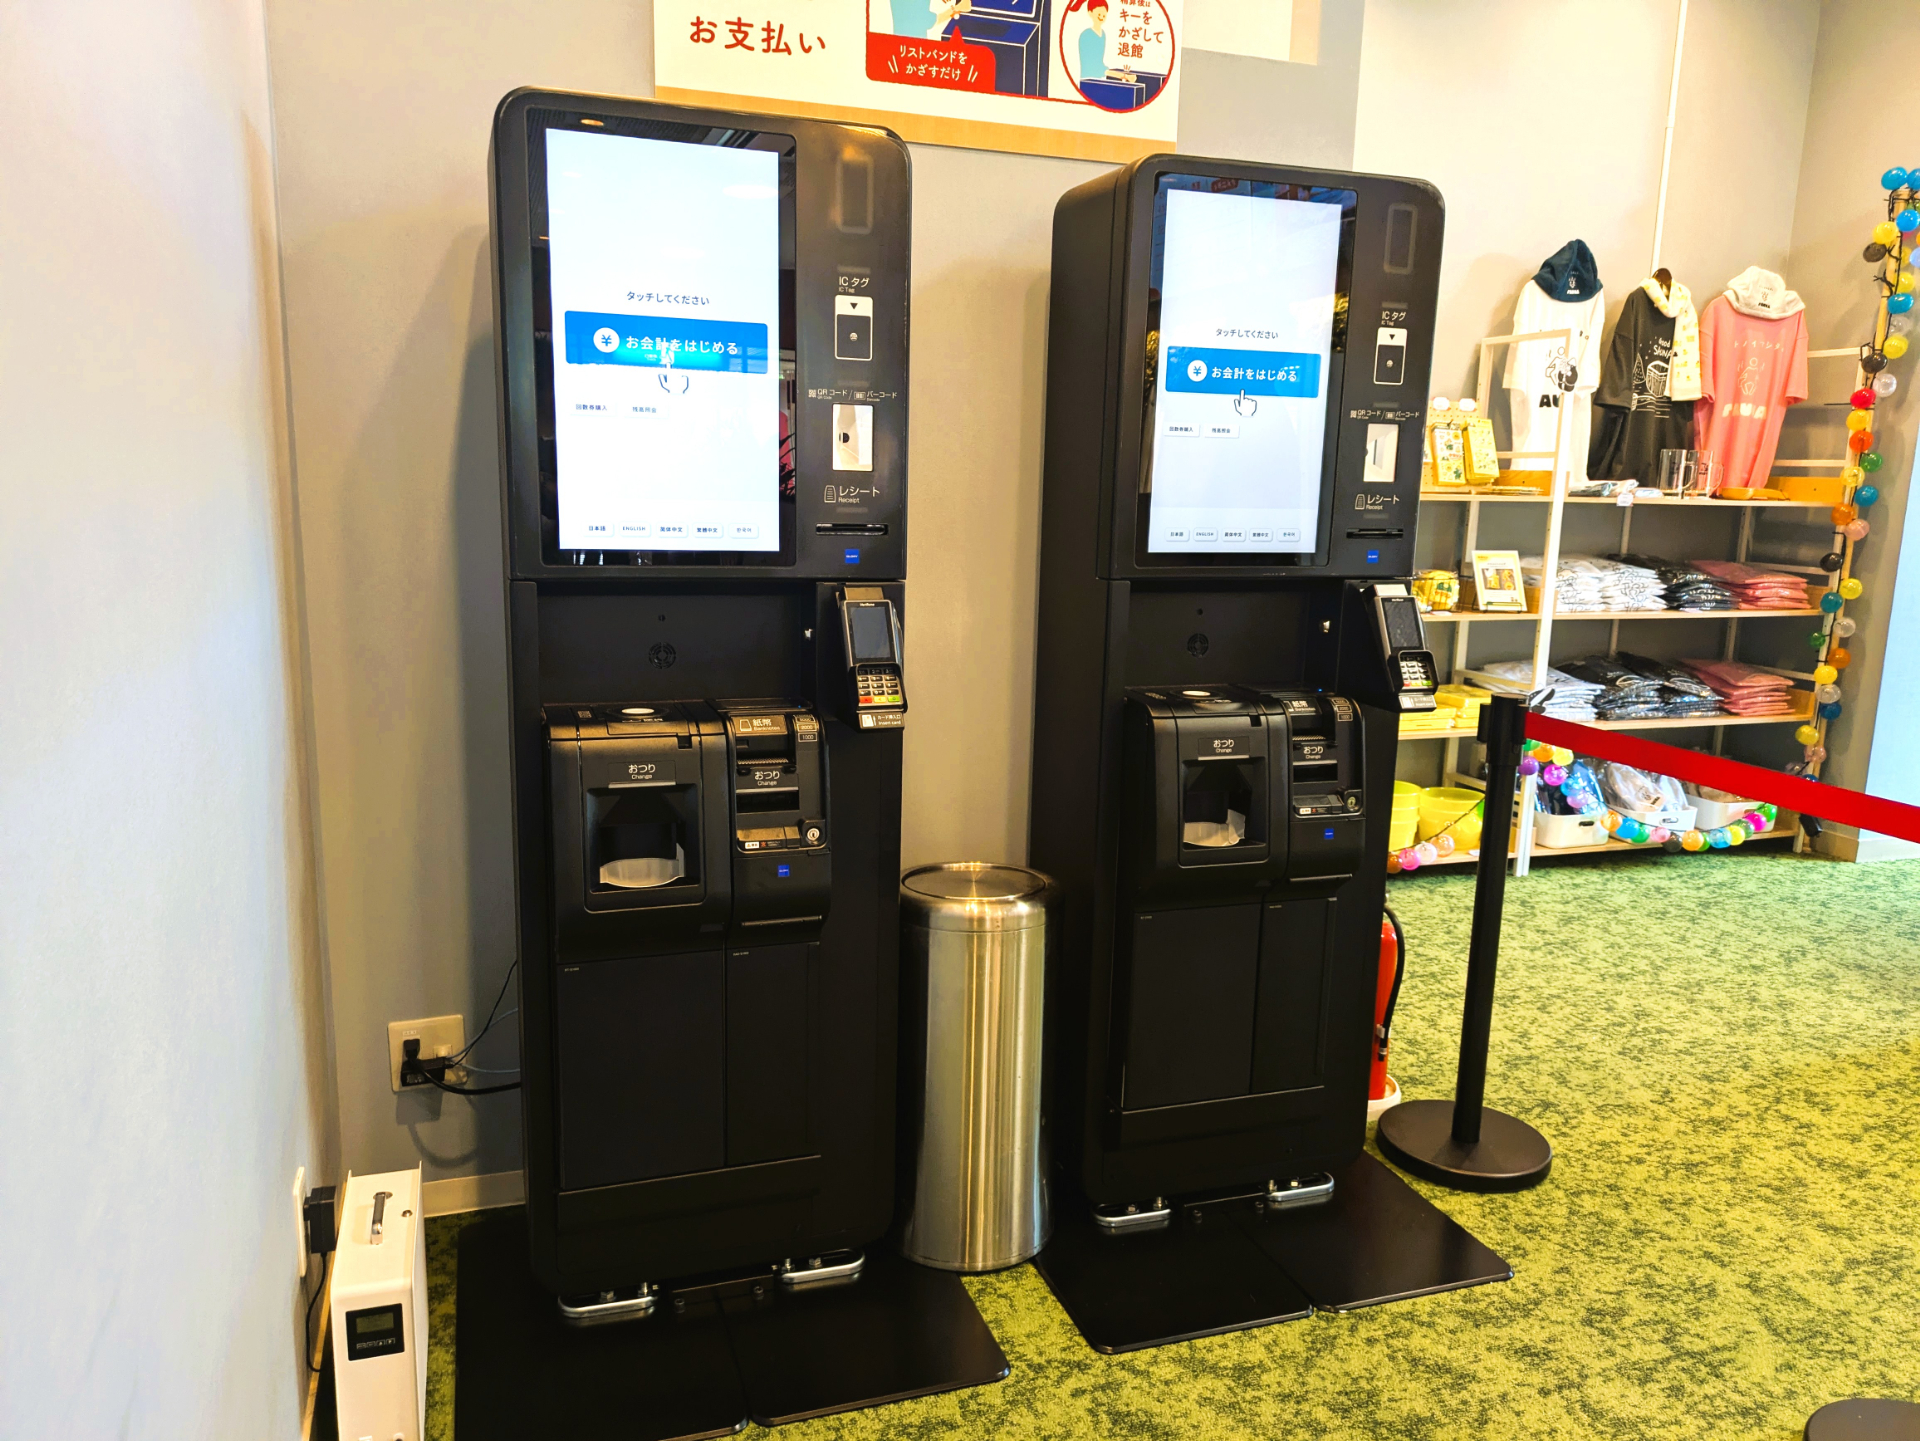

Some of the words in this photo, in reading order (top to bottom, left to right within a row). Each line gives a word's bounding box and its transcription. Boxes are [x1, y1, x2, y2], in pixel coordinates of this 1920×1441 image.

[1119, 8, 1152, 25] キーを
[690, 16, 826, 56] お支払い
[1118, 26, 1164, 44] かざして
[900, 44, 968, 64] リストバンドを
[1117, 42, 1144, 58] 退館
[905, 63, 961, 81] かざすだけ
[851, 277, 870, 287] タグ
[627, 291, 710, 305] タッチしてください
[1216, 328, 1278, 339] タッチしてください
[626, 336, 738, 355] お会計をはじめる
[1211, 366, 1297, 382] お会計をはじめる
[839, 486, 880, 497] レシート
[1367, 494, 1400, 504] レシート
[753, 718, 772, 727] 紙幣
[1213, 739, 1234, 748] おつり
[1303, 746, 1324, 754] おつり
[628, 764, 656, 774] おつり
[754, 770, 780, 781] おつり
